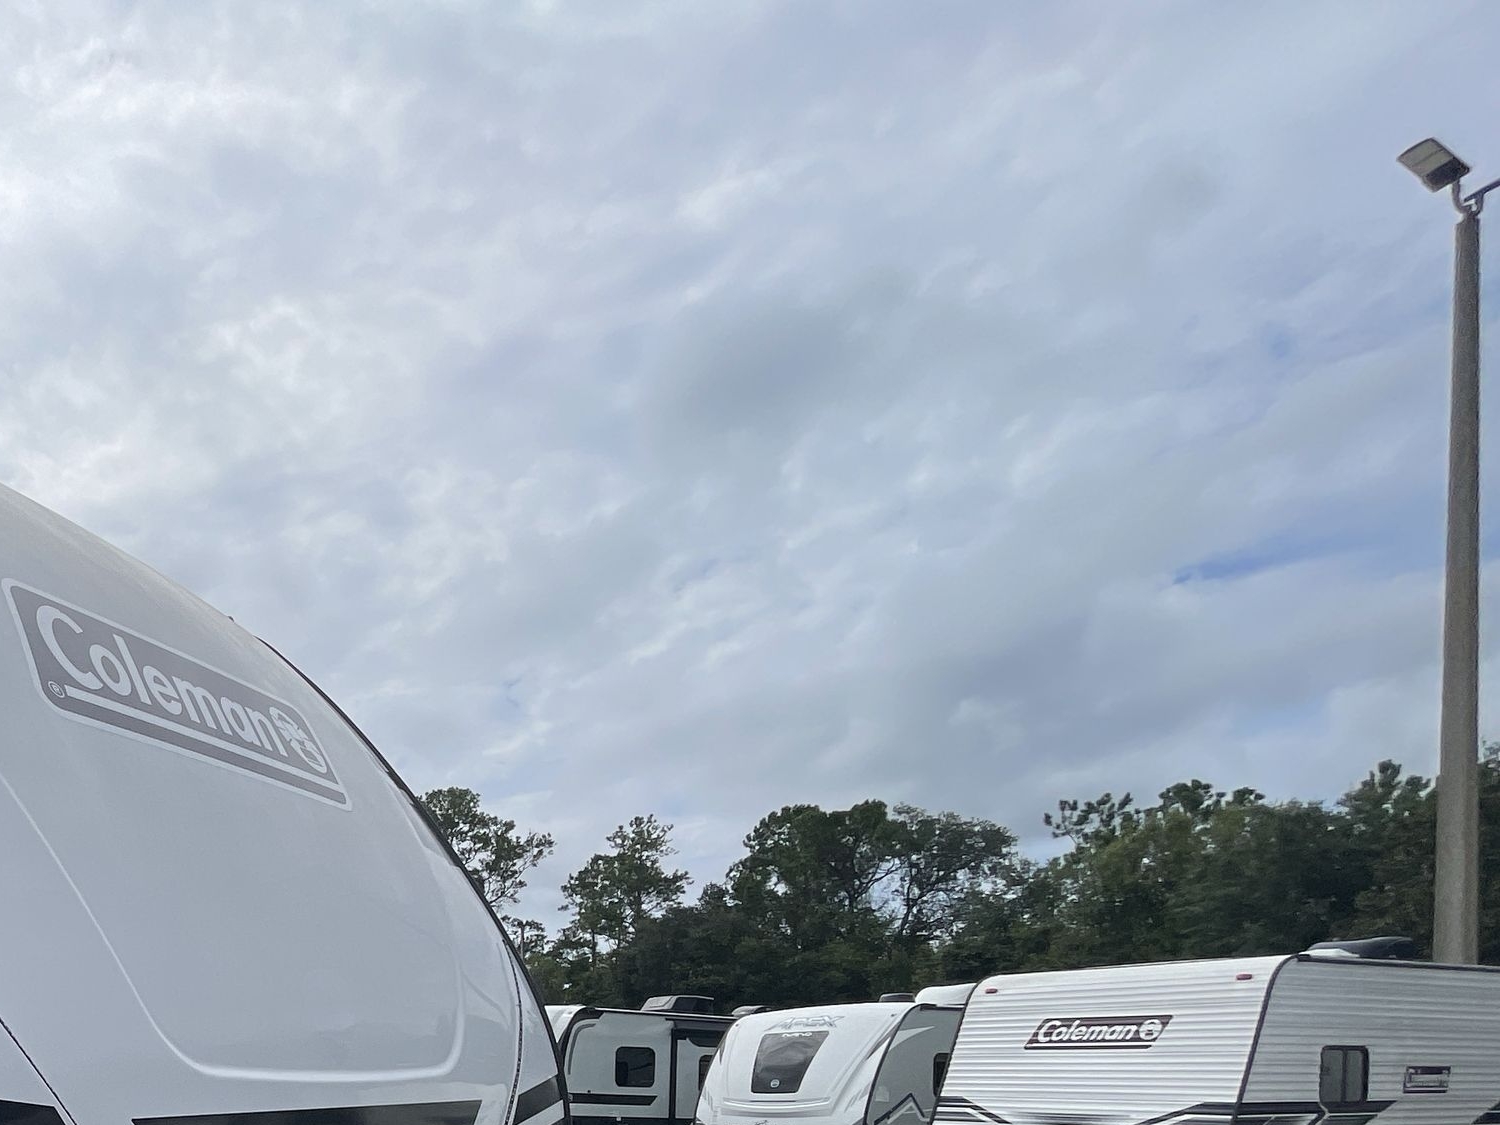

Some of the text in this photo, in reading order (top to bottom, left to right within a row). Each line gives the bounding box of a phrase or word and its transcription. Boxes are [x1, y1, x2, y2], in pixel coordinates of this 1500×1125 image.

[36, 604, 288, 757] Coleman
[764, 1014, 845, 1030] APEX
[1037, 1019, 1138, 1043] Coleman
